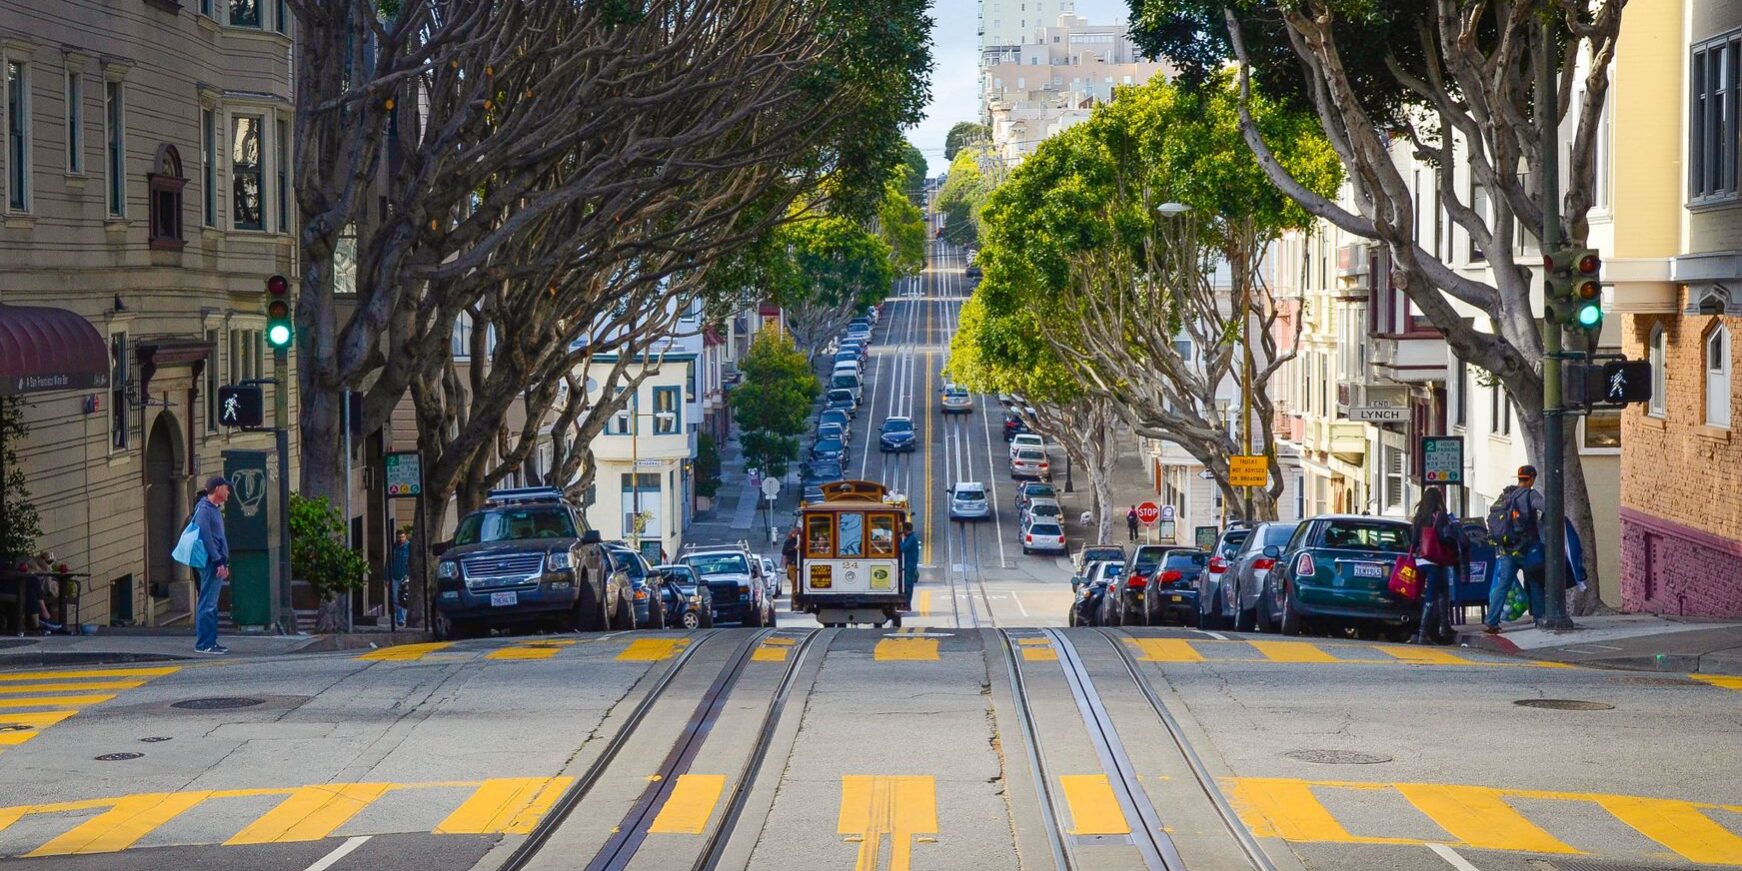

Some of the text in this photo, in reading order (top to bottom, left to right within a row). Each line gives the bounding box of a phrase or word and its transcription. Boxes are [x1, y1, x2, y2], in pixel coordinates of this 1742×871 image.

[37, 375, 54, 387] Francisco
[54, 375, 62, 385] Wine
[1361, 410, 1399, 419] LYNCH
[1426, 441, 1435, 451] 2
[1138, 508, 1158, 517] STOP
[842, 561, 859, 569] 24
